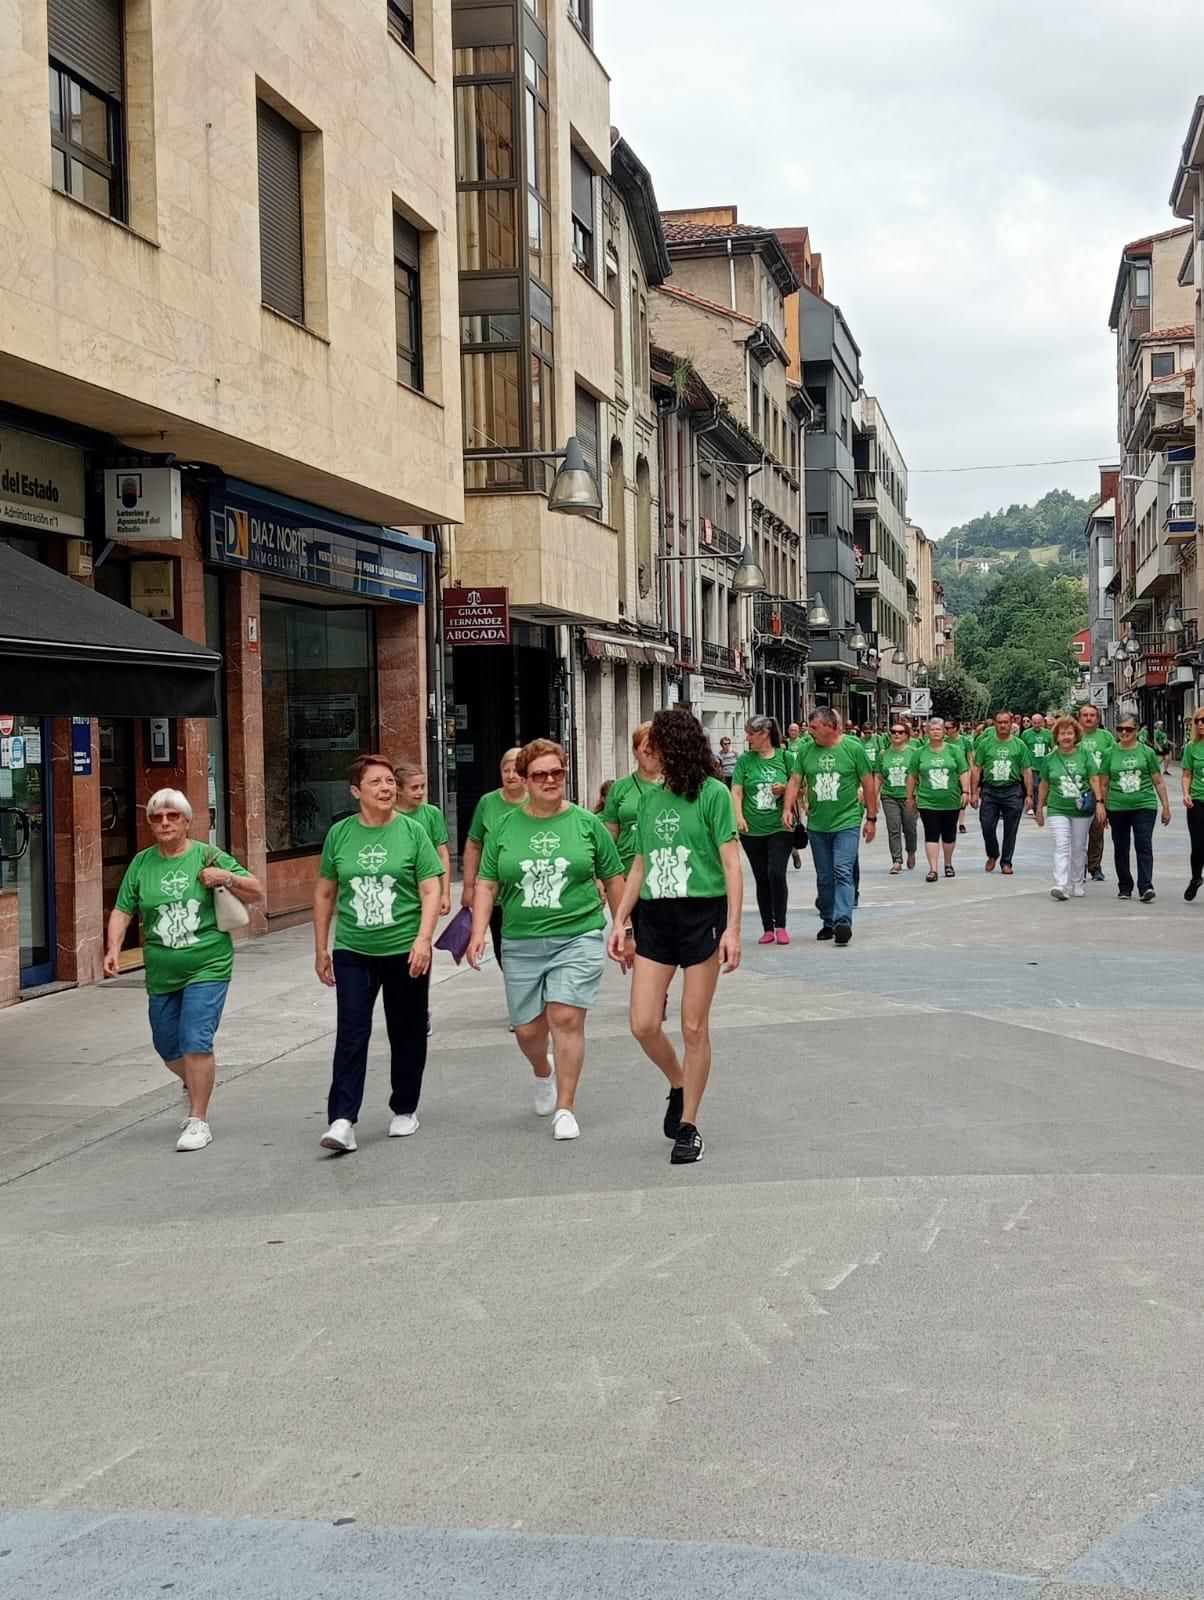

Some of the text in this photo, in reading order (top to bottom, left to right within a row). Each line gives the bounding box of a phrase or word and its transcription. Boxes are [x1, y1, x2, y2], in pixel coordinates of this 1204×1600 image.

[2, 469, 59, 502] del Estado
[277, 526, 307, 556] NORTE
[446, 630, 505, 640] ABOGADA
